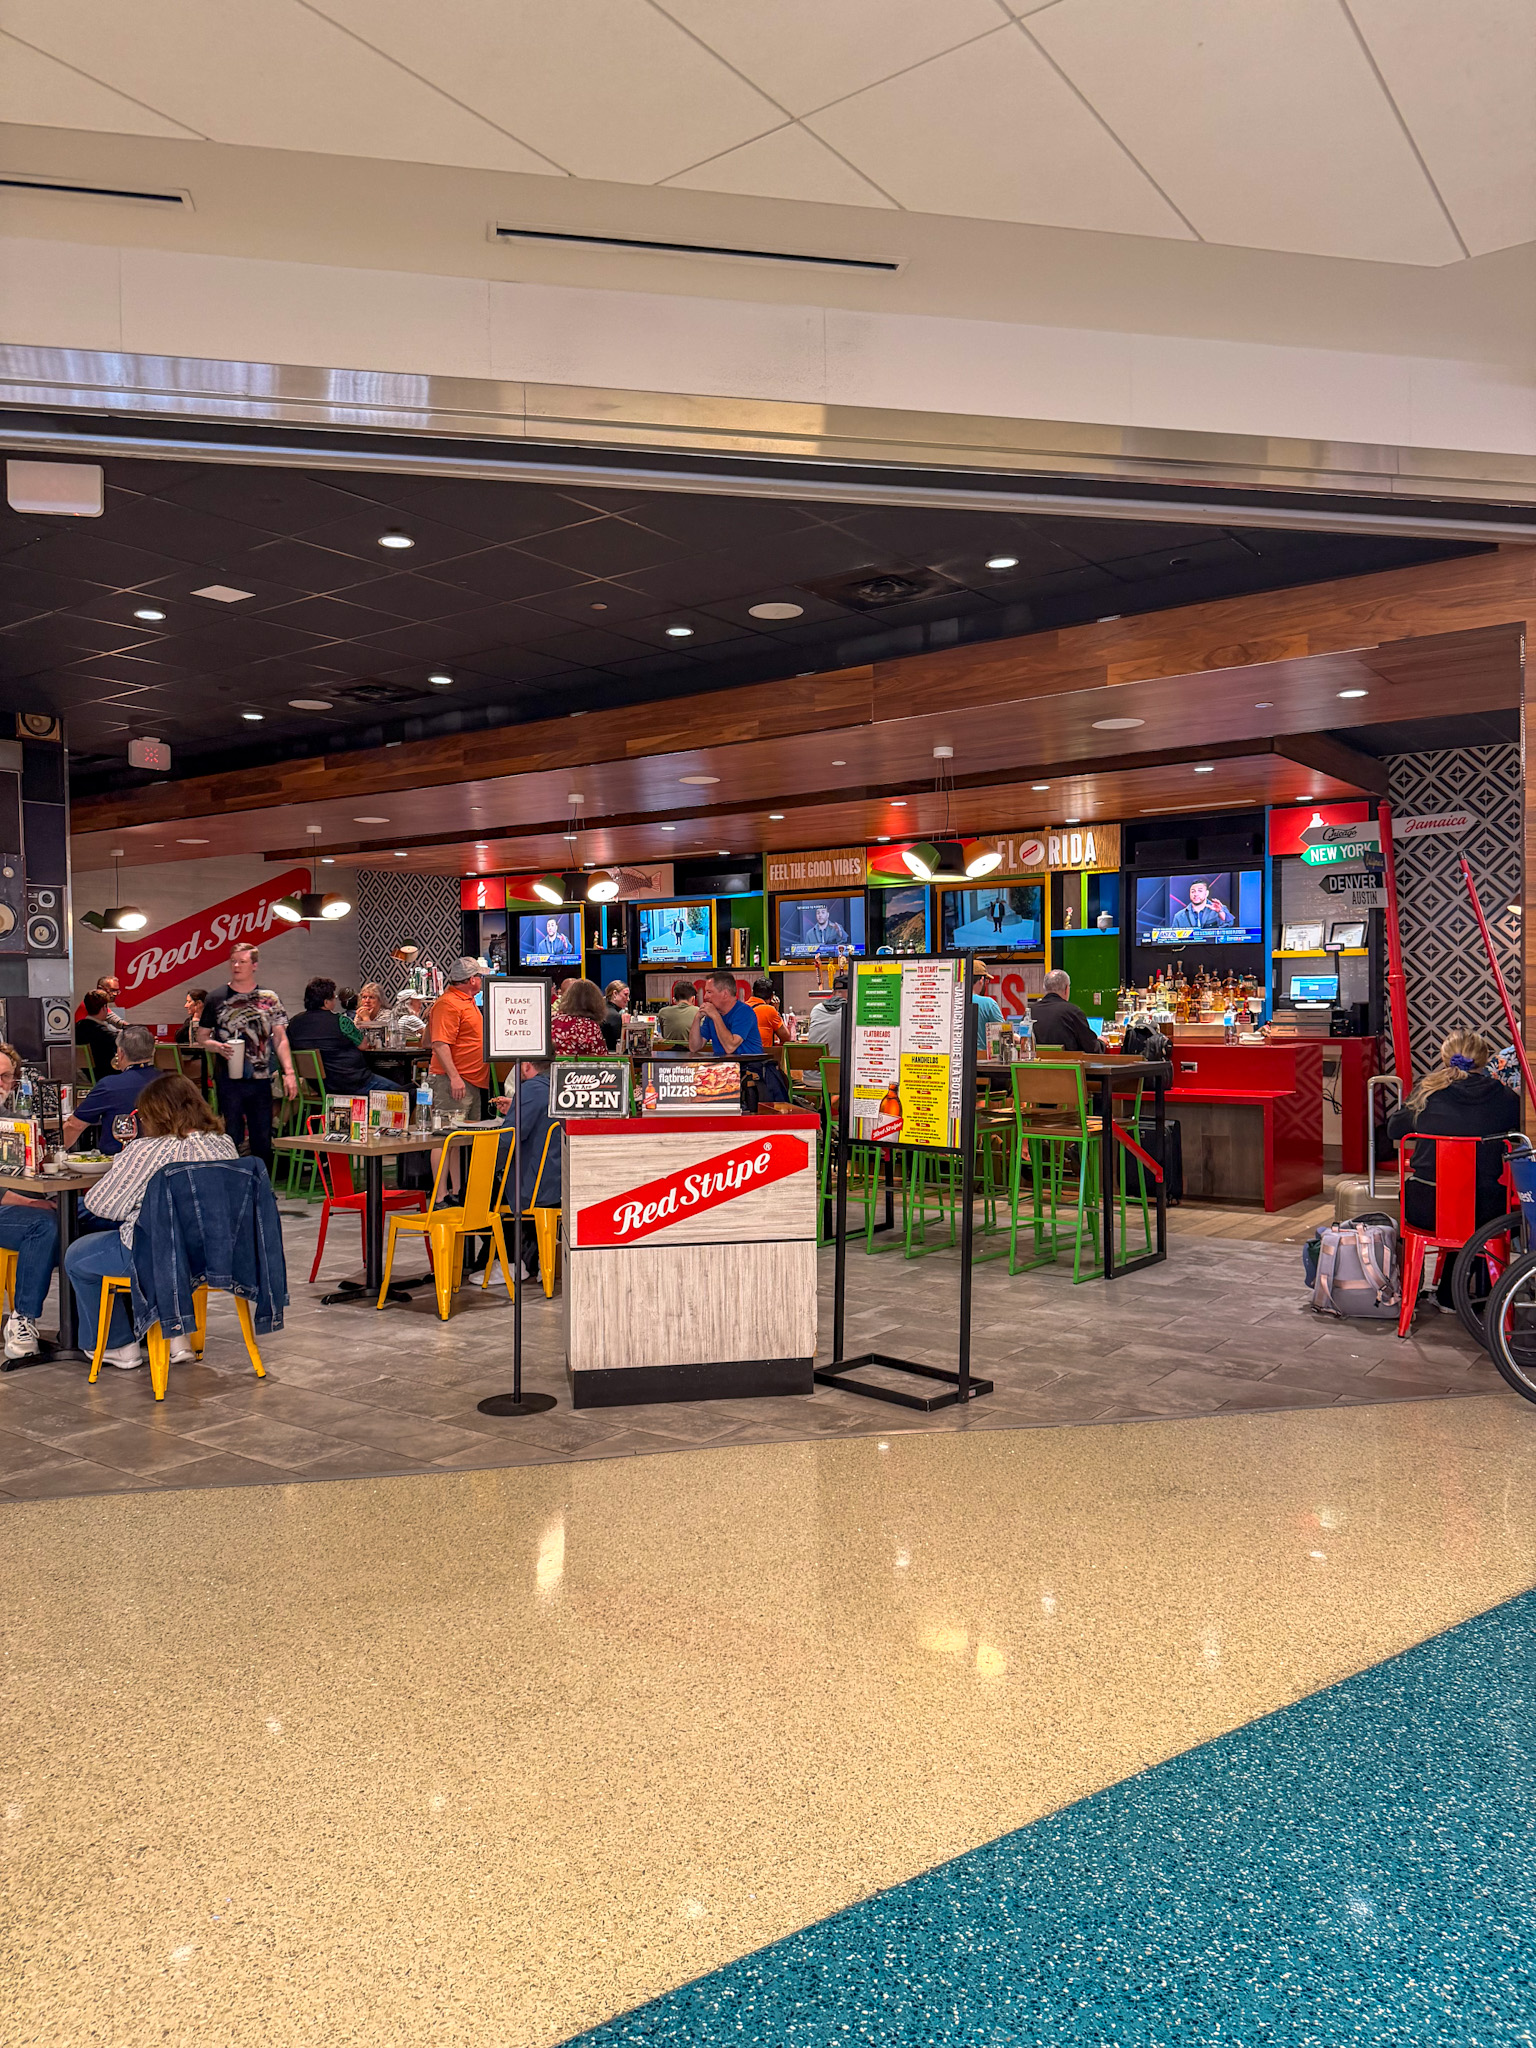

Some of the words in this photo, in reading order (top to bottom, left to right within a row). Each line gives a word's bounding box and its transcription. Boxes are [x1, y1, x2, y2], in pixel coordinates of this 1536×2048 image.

[1404, 815, 1468, 833] Jamaica
[1322, 826, 1357, 841] Chicago
[1310, 847, 1337, 863] NEW
[1339, 842, 1372, 859] YORK
[769, 864, 789, 881] FEEL
[789, 862, 806, 879] THE
[807, 860, 832, 878] GOOD
[832, 857, 861, 875] VIBES
[1329, 874, 1376, 891] DENVER
[1352, 890, 1378, 905] AUSTIN
[125, 930, 203, 990] Red
[917, 966, 924, 974] TO
[953, 985, 964, 1030] JAMAICAN
[507, 1018, 518, 1026] TO
[518, 1018, 528, 1026] BE
[863, 1030, 891, 1038] FLATBREADS
[953, 1031, 963, 1058] PRIDE
[911, 1056, 939, 1064] HANDHELDS
[952, 1058, 962, 1068] IN
[564, 1071, 597, 1085] Come
[598, 1070, 617, 1085] In
[658, 1073, 694, 1084] flatbread
[671, 1066, 695, 1076] offering
[557, 1090, 621, 1110] OPEN
[658, 1084, 698, 1101] pizzas
[612, 1187, 680, 1236] Red
[679, 1152, 772, 1207] Stripe
